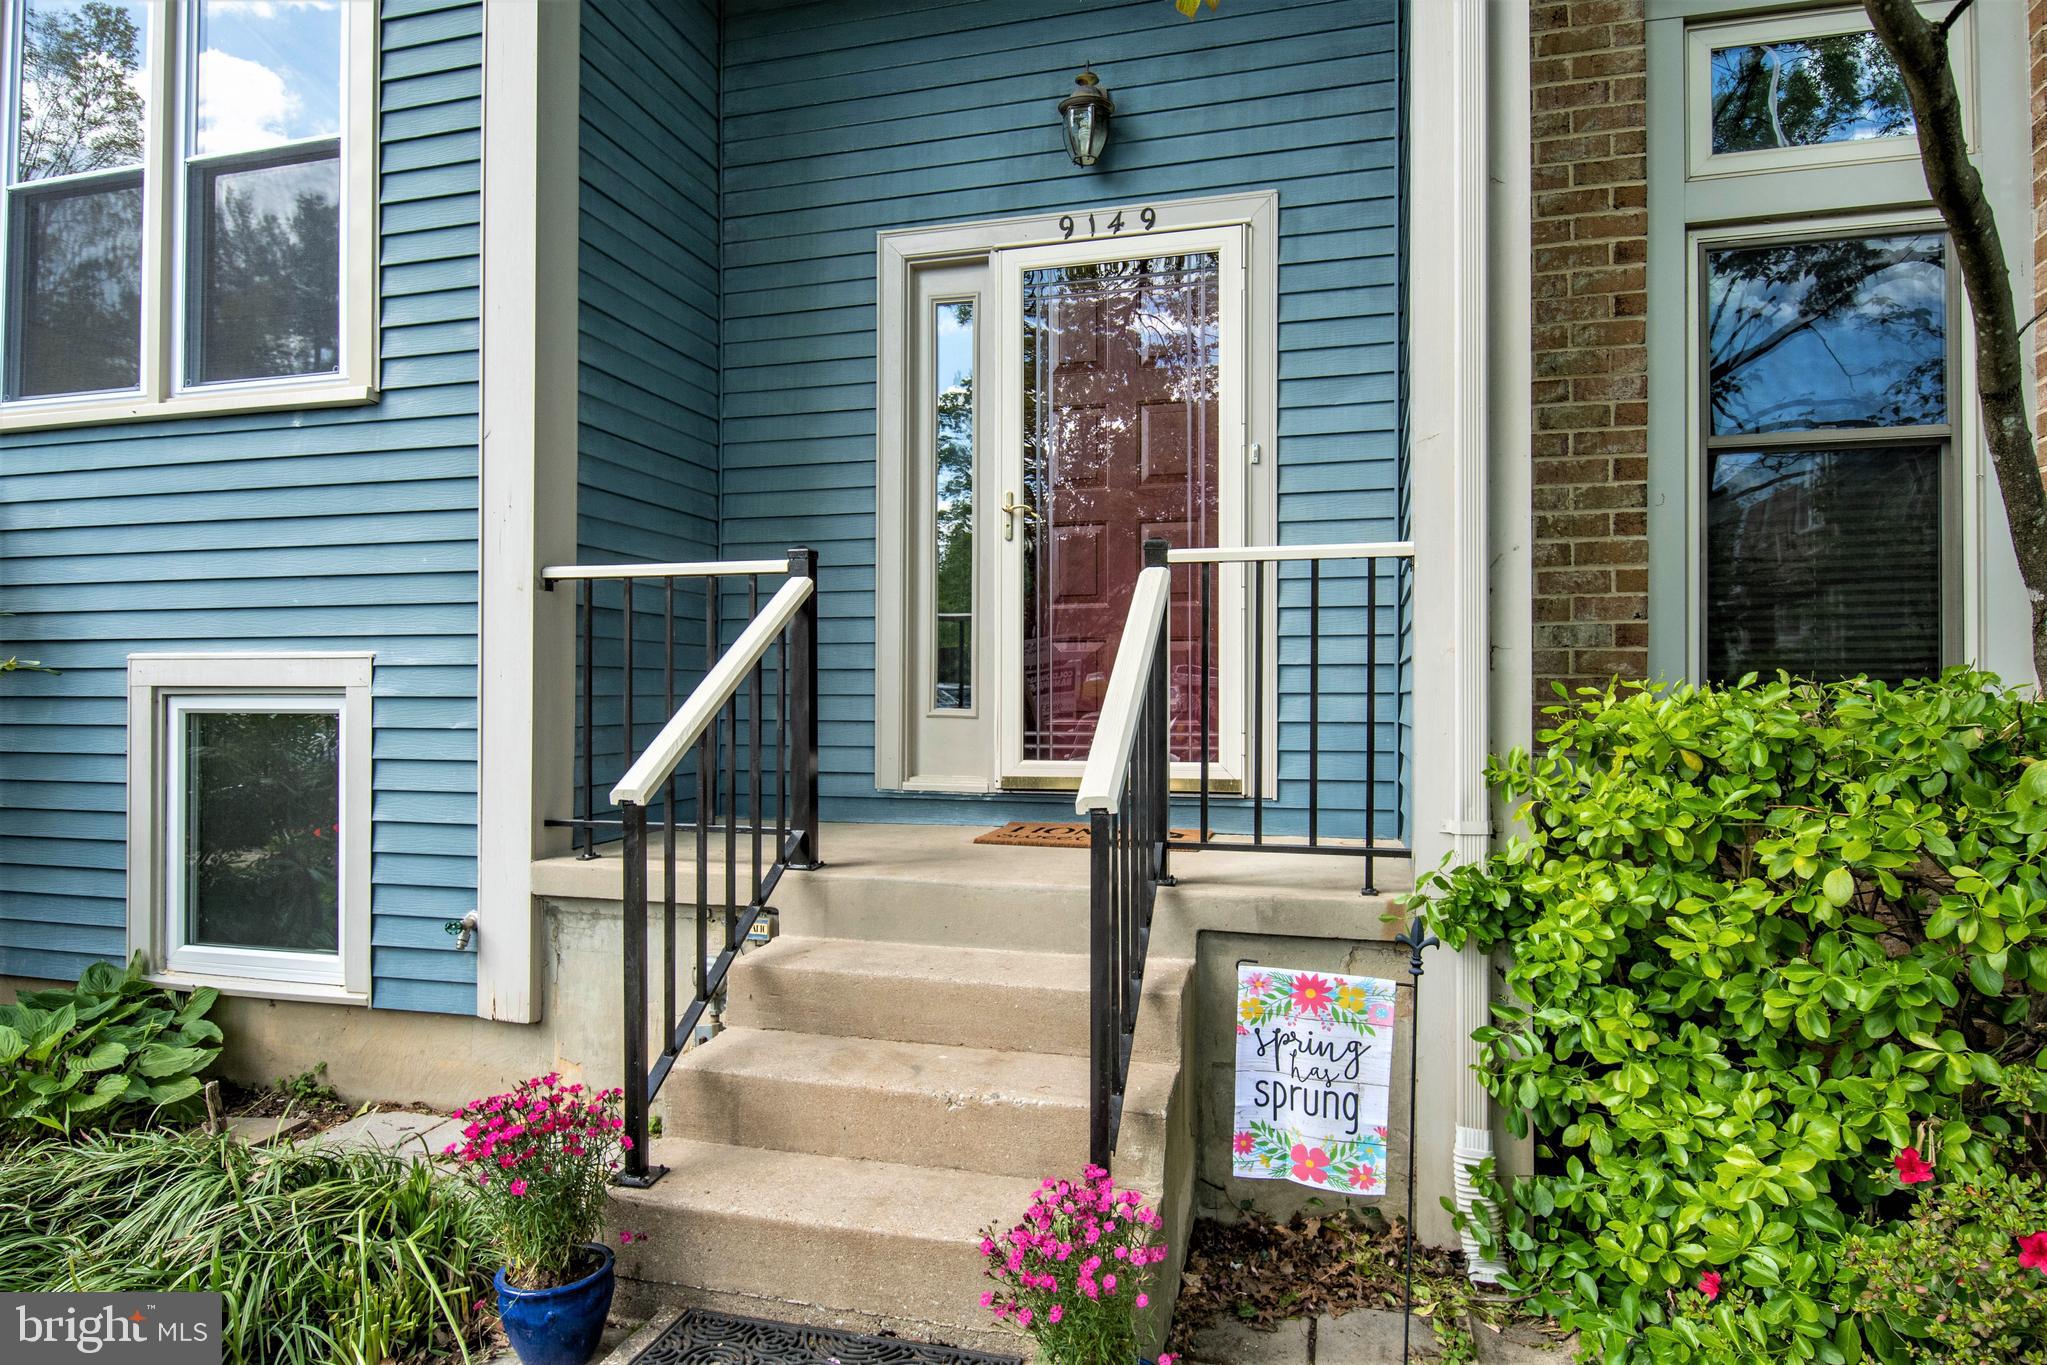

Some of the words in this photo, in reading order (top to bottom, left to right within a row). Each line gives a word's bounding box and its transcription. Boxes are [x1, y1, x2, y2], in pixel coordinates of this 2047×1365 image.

[1059, 208, 1156, 240] 9149
[1254, 1028, 1371, 1080] spring
[1290, 1048, 1340, 1088] has
[1254, 1080, 1359, 1135] sprung
